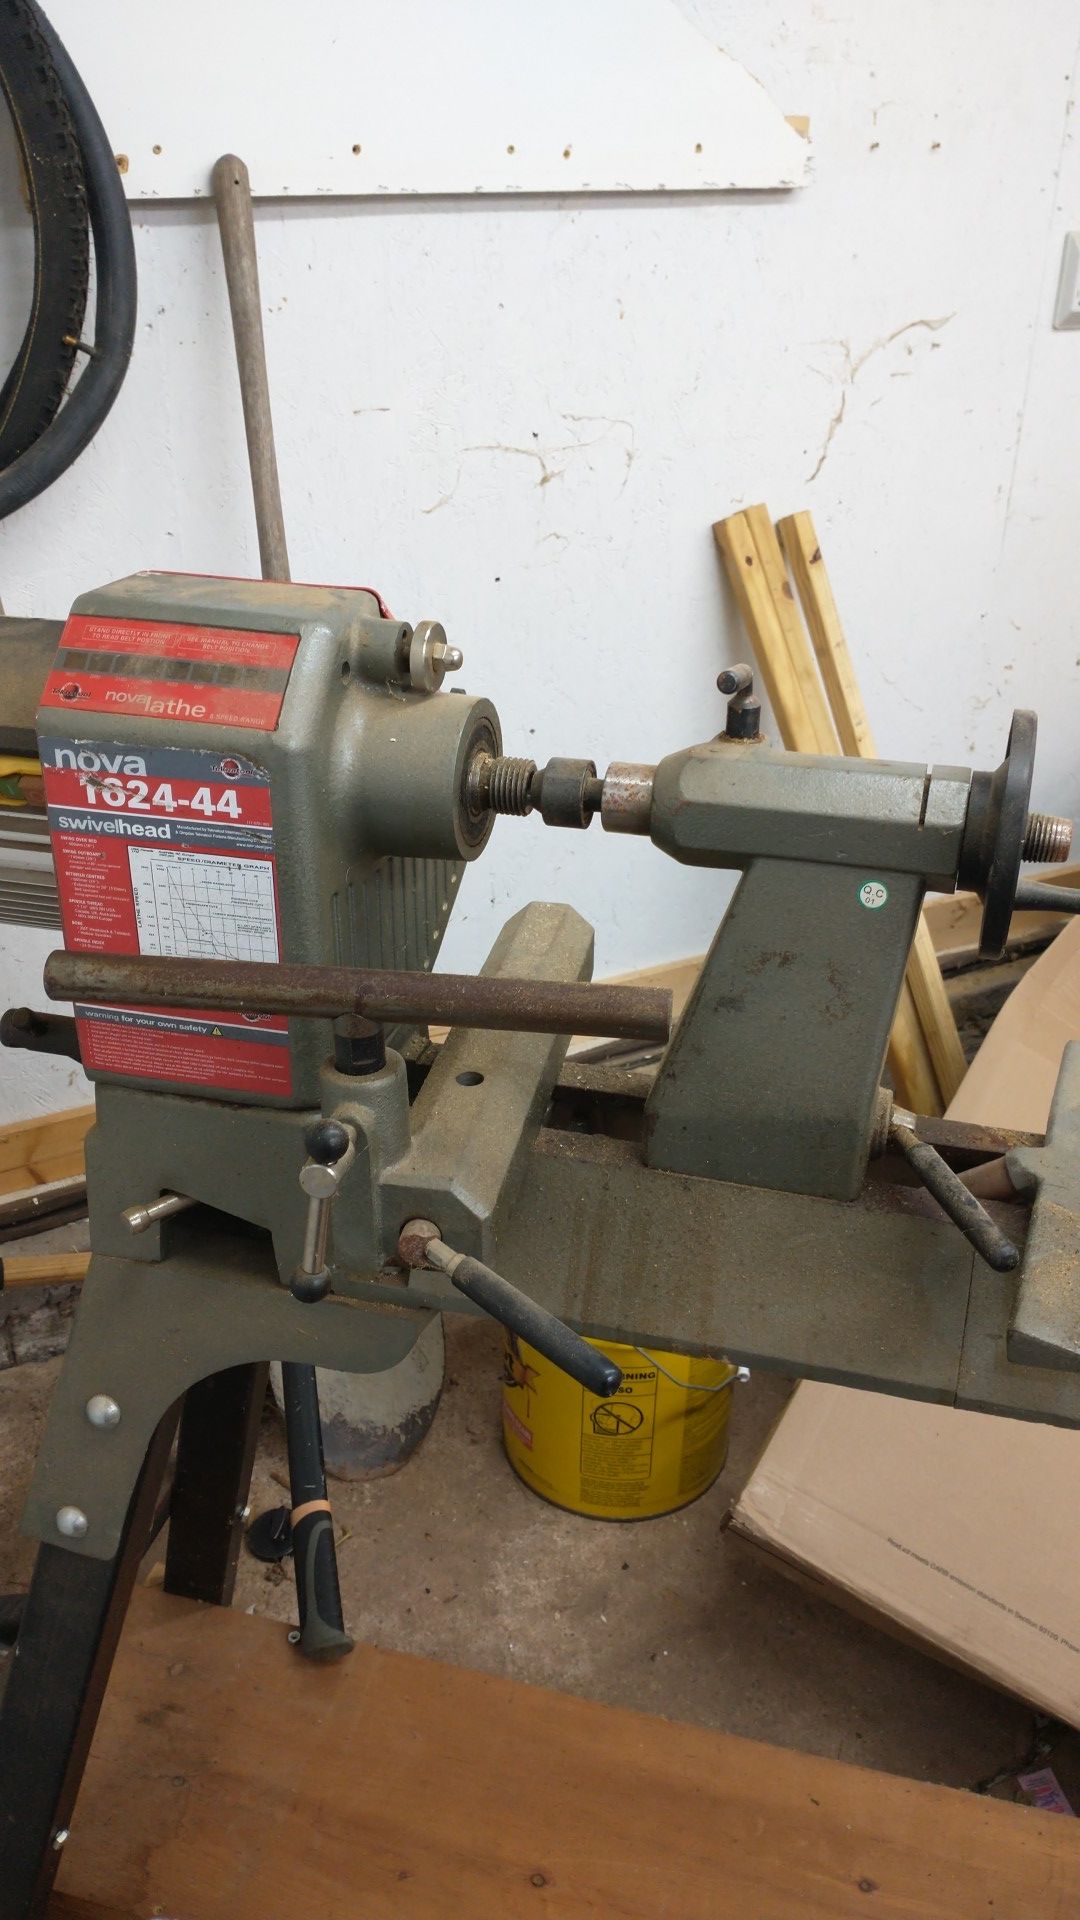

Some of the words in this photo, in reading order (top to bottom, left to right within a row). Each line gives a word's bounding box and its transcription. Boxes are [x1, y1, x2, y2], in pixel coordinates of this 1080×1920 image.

[54, 748, 147, 777] nova
[80, 776, 242, 819] 1624-44
[58, 815, 171, 839] swivelhead
[85, 1011, 119, 1022] warning
[121, 1015, 133, 1023] for
[135, 1017, 155, 1026] your
[157, 1020, 177, 1029] own
[179, 1023, 208, 1034] safety
[621, 1371, 656, 1380] NING
